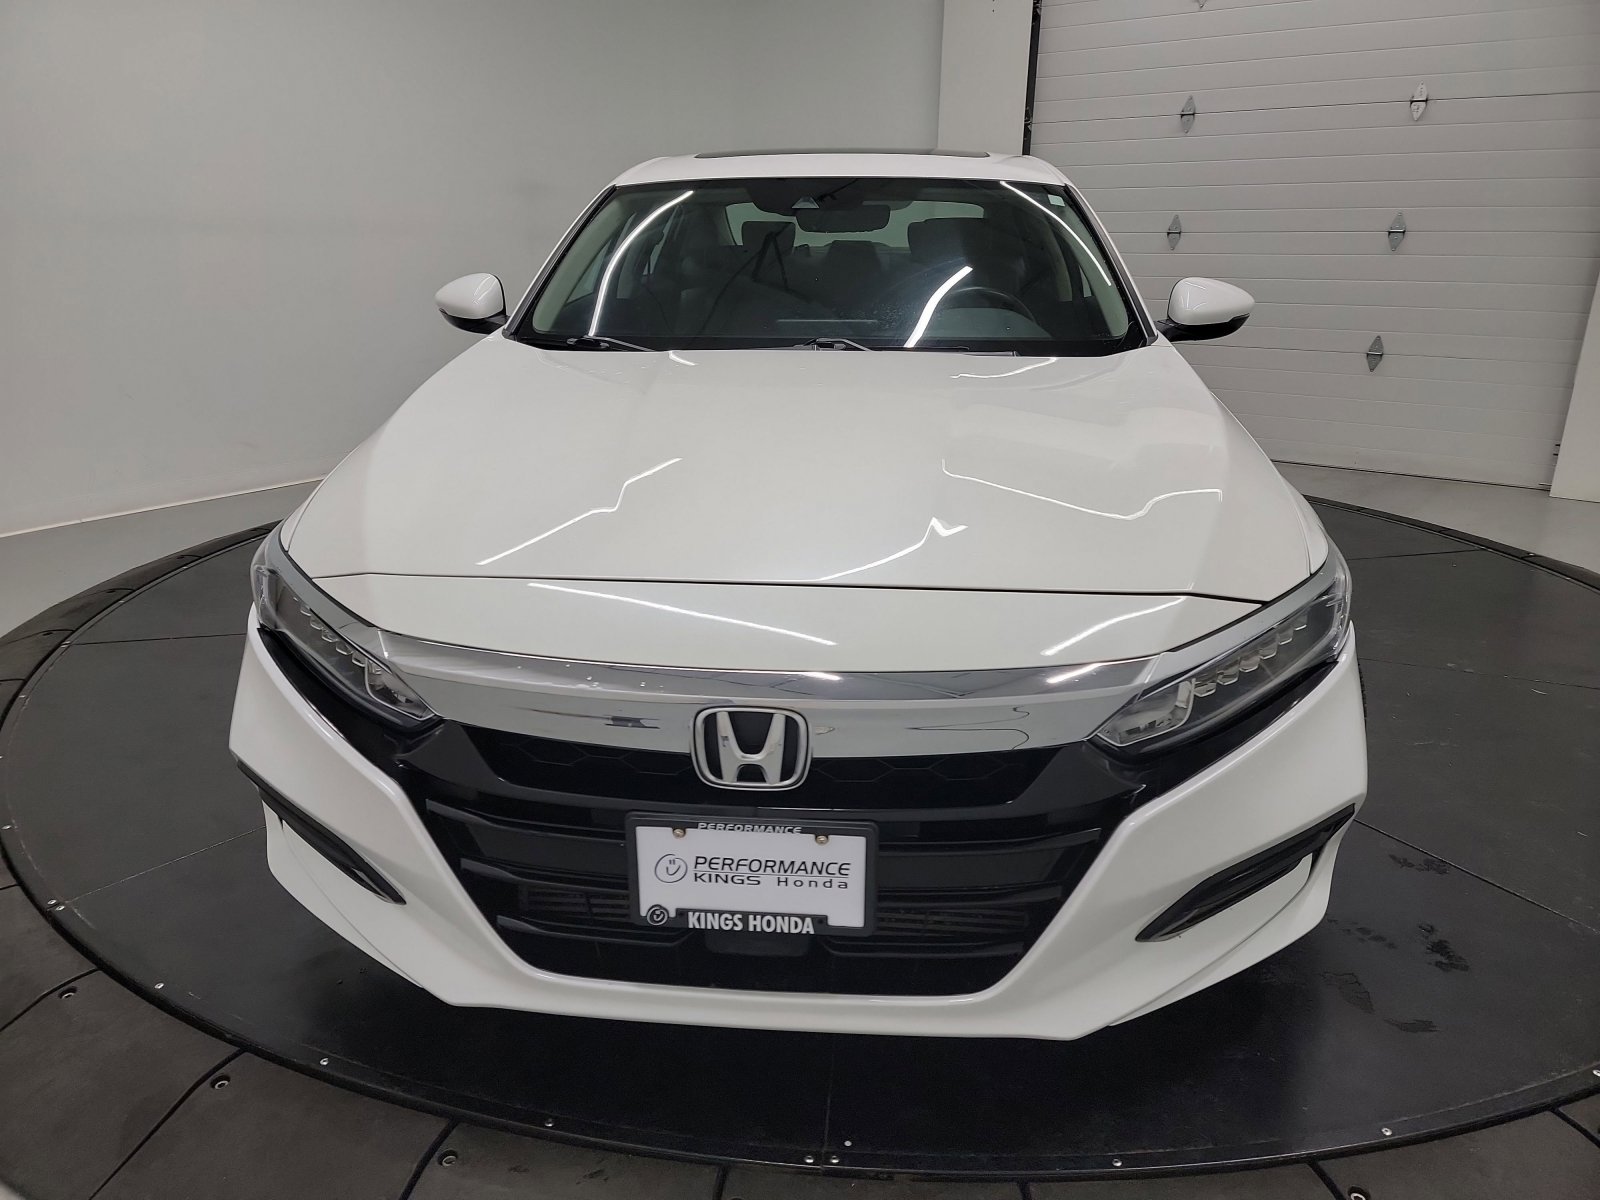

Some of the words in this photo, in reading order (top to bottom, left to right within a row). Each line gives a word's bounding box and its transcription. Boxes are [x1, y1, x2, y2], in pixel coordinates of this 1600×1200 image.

[698, 822, 802, 834] PERFORMANCE
[694, 856, 851, 876] PERFORMANCE
[694, 873, 760, 886] KINGS
[777, 877, 848, 889] Honda
[688, 912, 743, 931] KINGS
[748, 915, 814, 935] HONDA
